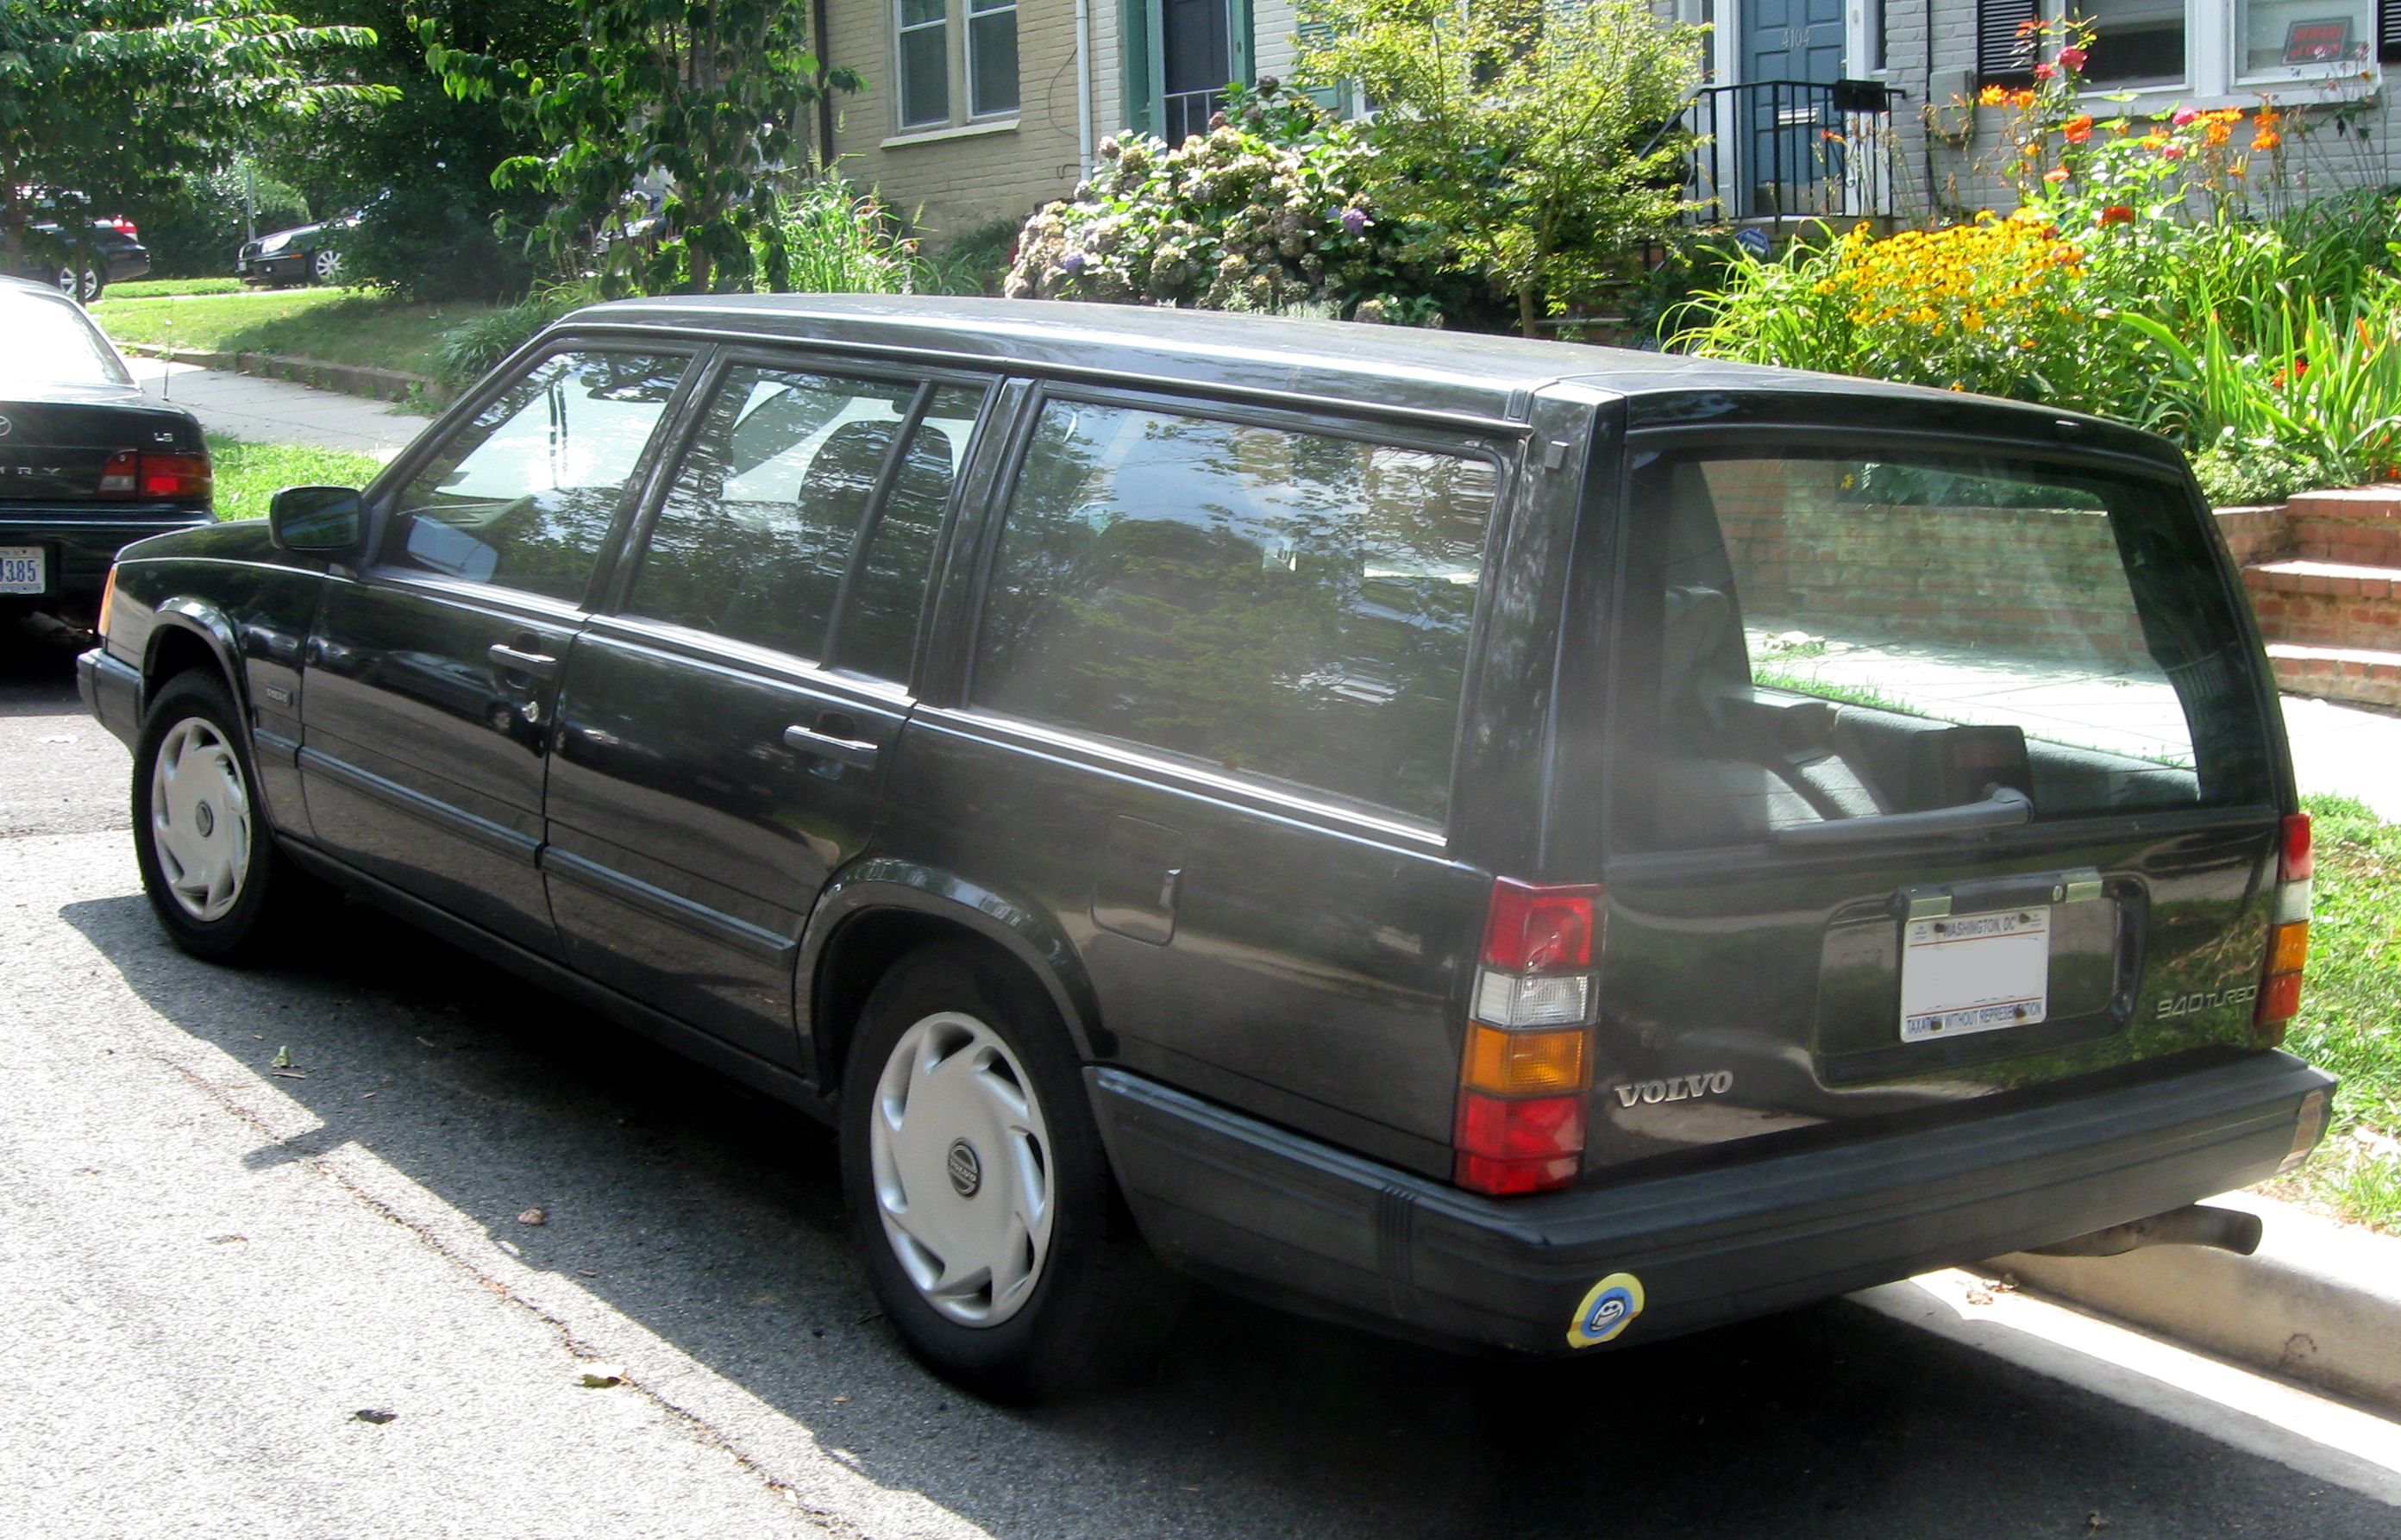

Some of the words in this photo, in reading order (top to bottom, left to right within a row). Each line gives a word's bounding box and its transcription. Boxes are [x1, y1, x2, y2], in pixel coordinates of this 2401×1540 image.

[1782, 27, 1810, 48] 4104
[2157, 993, 2204, 1020] 940
[2205, 985, 2258, 1008] TURBO
[1614, 1070, 1734, 1108] VOLVO
